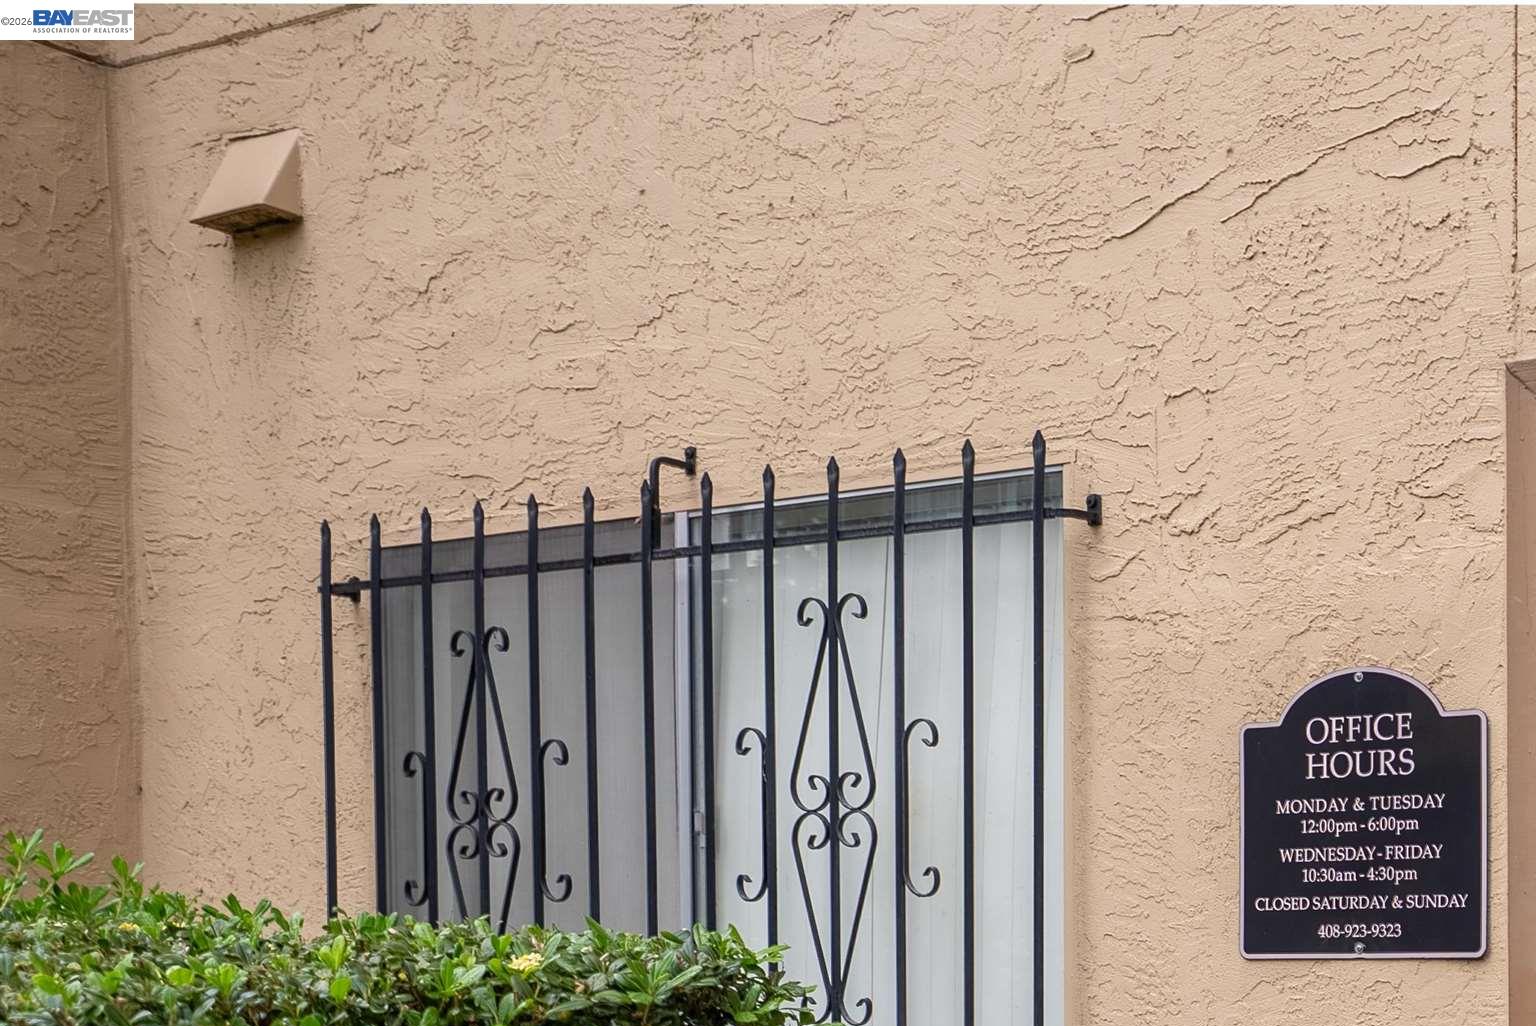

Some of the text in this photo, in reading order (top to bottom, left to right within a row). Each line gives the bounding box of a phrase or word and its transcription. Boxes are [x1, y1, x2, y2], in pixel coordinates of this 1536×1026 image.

[1306, 713, 1413, 744] OFFICE
[1305, 748, 1415, 779] HOURS
[1275, 794, 1446, 814] MONDAY & TUESDAY
[1301, 818, 1358, 837] 12:00pm
[1368, 816, 1419, 835] 6:00pm
[1302, 868, 1357, 883] 10:30am
[1367, 866, 1418, 885] 4:30pm
[1255, 894, 1469, 911] CLOSED SATURDAY & SUNDAY
[1318, 923, 1402, 938] 408-923-9323
